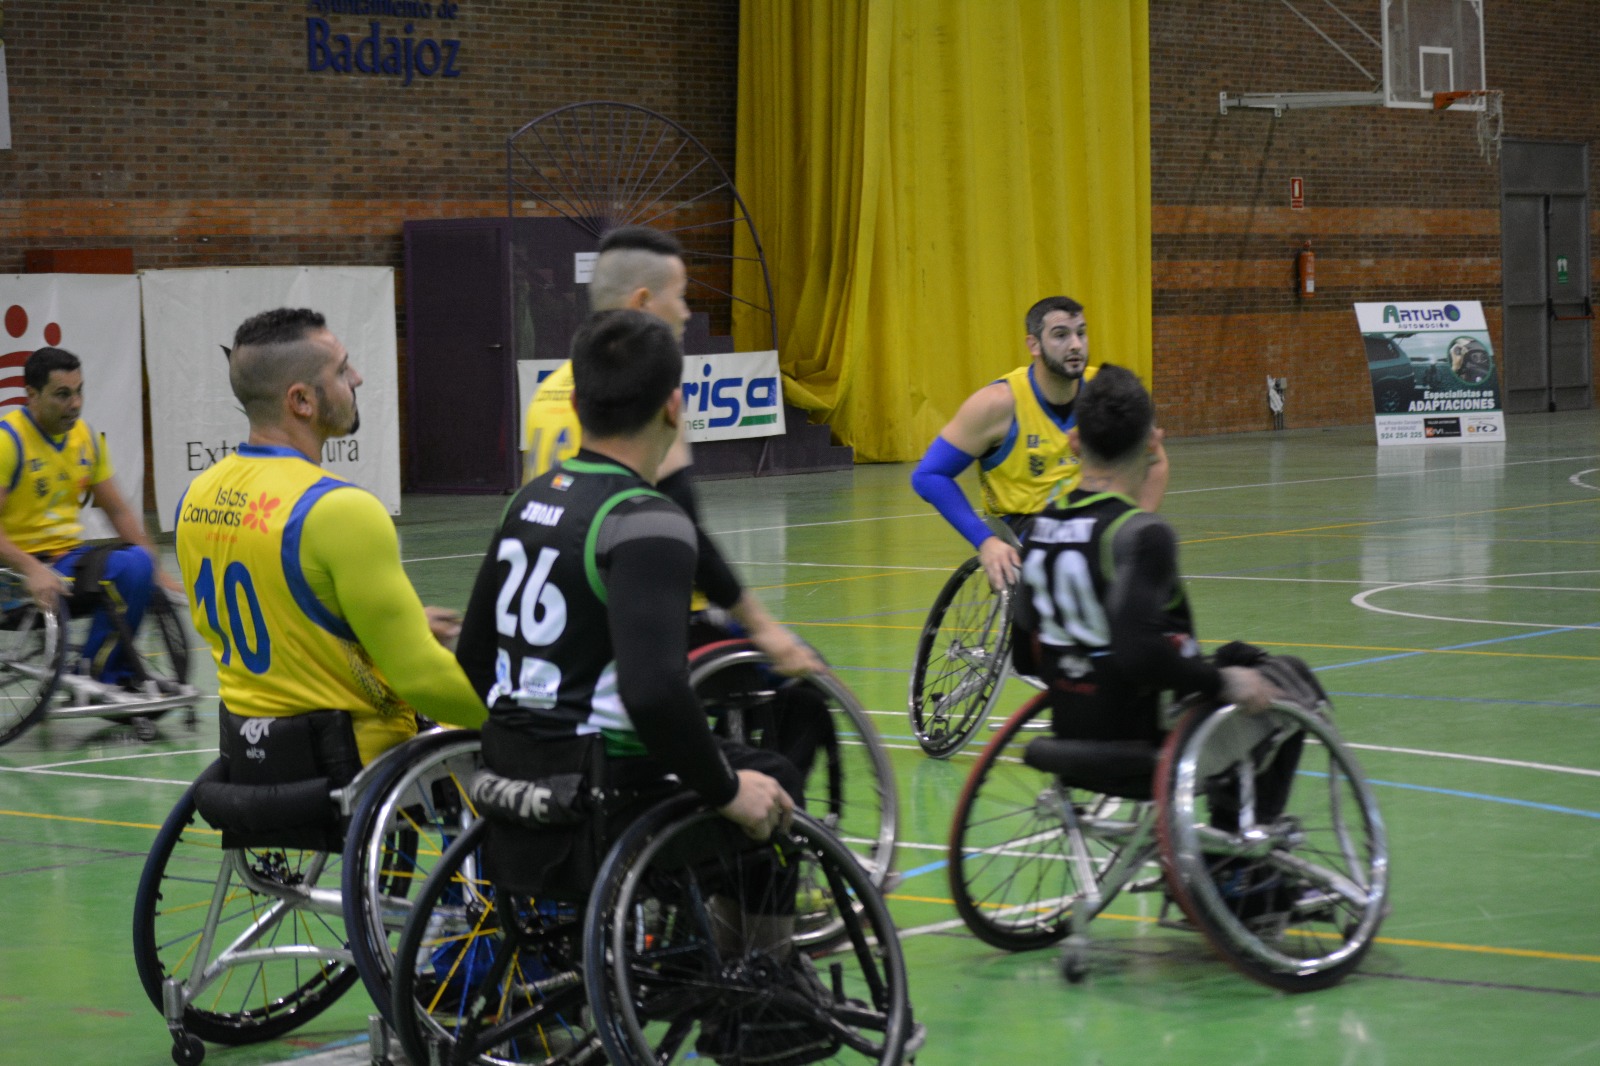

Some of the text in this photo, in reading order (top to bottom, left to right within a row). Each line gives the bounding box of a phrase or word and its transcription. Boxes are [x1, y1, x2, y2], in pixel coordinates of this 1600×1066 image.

[306, 17, 461, 87] Badajoz
[1383, 304, 1461, 324] ARTURO
[681, 363, 778, 428] risa
[1408, 398, 1496, 412] ADAPTACIONES
[1423, 390, 1494, 400] Especialistas en
[214, 487, 249, 508] Islas
[520, 501, 565, 526] JHOAN
[496, 538, 567, 647] 26
[194, 557, 271, 675] 10
